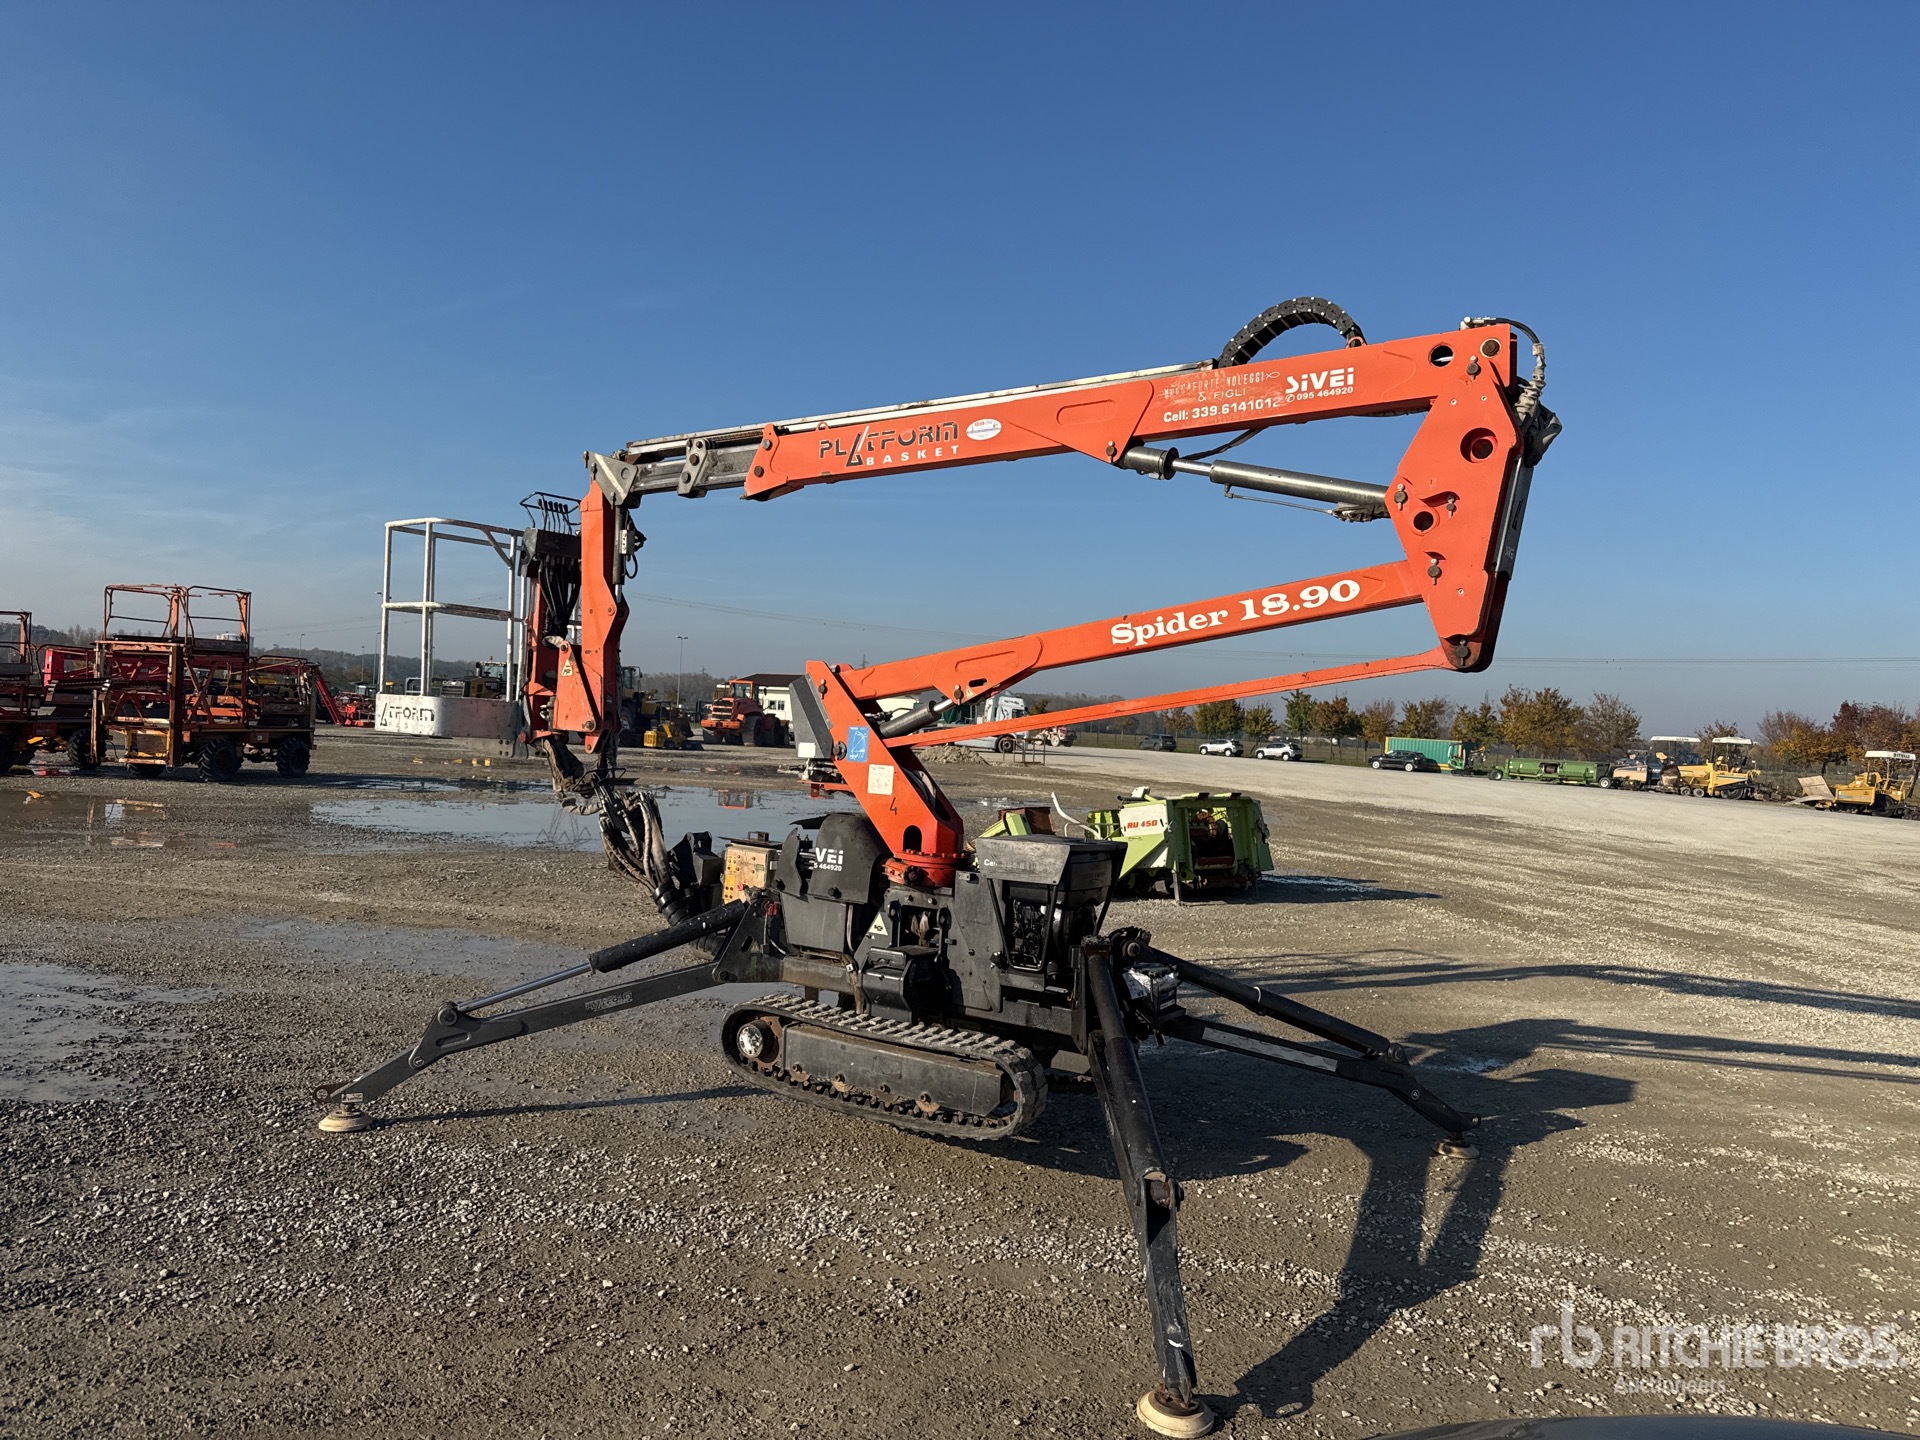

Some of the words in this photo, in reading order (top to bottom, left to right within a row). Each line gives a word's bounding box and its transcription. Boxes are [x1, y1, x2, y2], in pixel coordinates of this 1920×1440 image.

[1197, 391, 1207, 402] &
[1213, 387, 1246, 400] FIGLI
[1296, 391, 1315, 401] 095
[1316, 386, 1354, 398] 464920
[1163, 410, 1189, 423] Cell:
[1192, 398, 1281, 419] 339.6141012
[866, 445, 960, 467] BASKET
[1110, 609, 1229, 647] Spider
[1238, 579, 1361, 622] 18.90
[889, 796, 898, 816] 4
[1127, 821, 1139, 829] RU
[1140, 819, 1158, 827] 450
[815, 847, 844, 865] VEi
[818, 862, 843, 872] 464920
